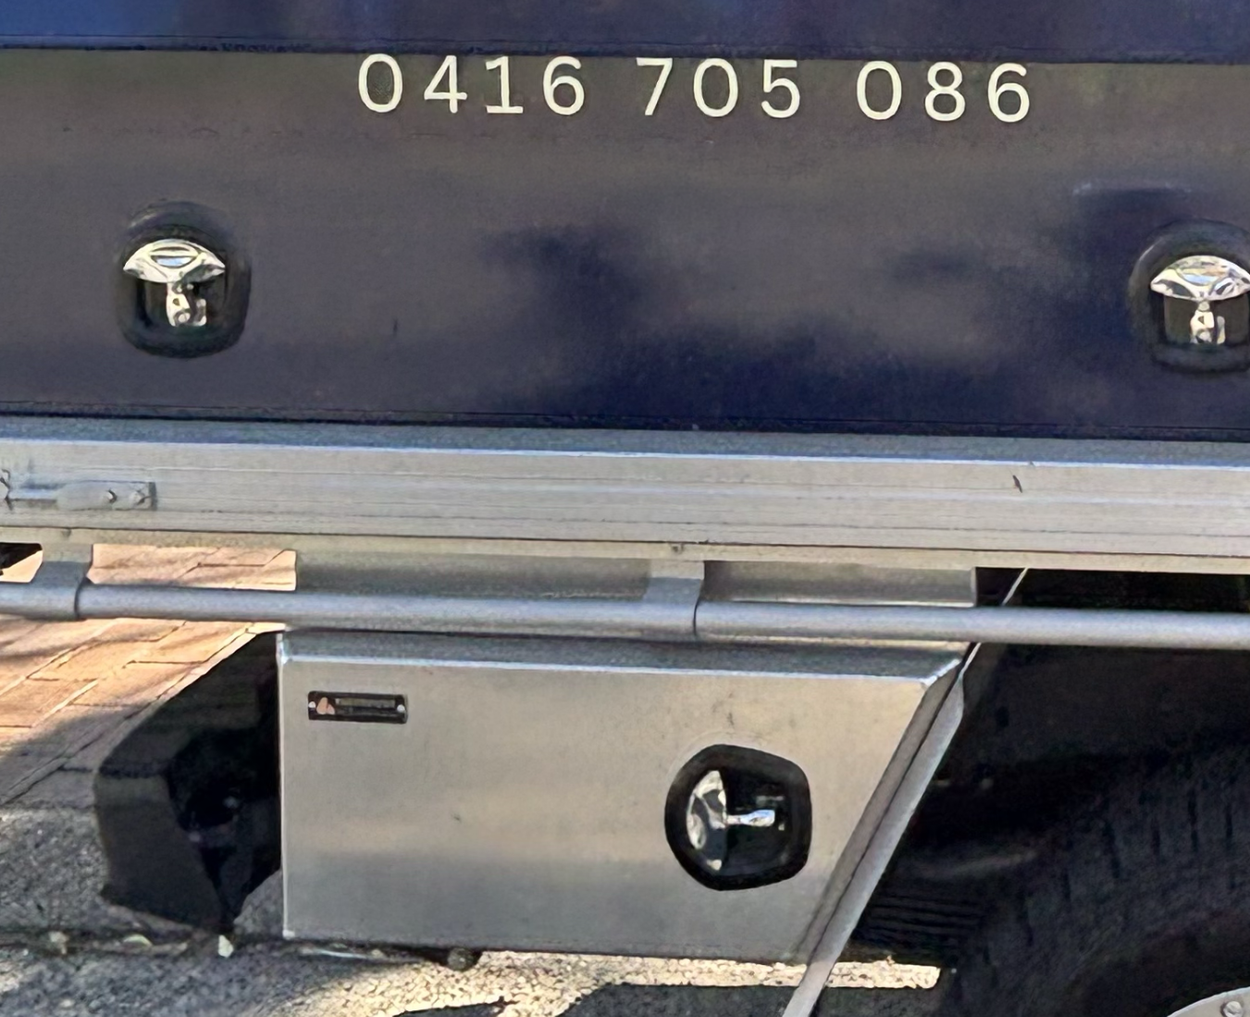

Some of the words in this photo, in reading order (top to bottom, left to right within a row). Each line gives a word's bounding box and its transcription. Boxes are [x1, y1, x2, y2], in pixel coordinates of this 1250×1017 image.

[358, 53, 585, 116] 0416
[636, 56, 801, 119] 705
[856, 60, 1030, 123] 086
